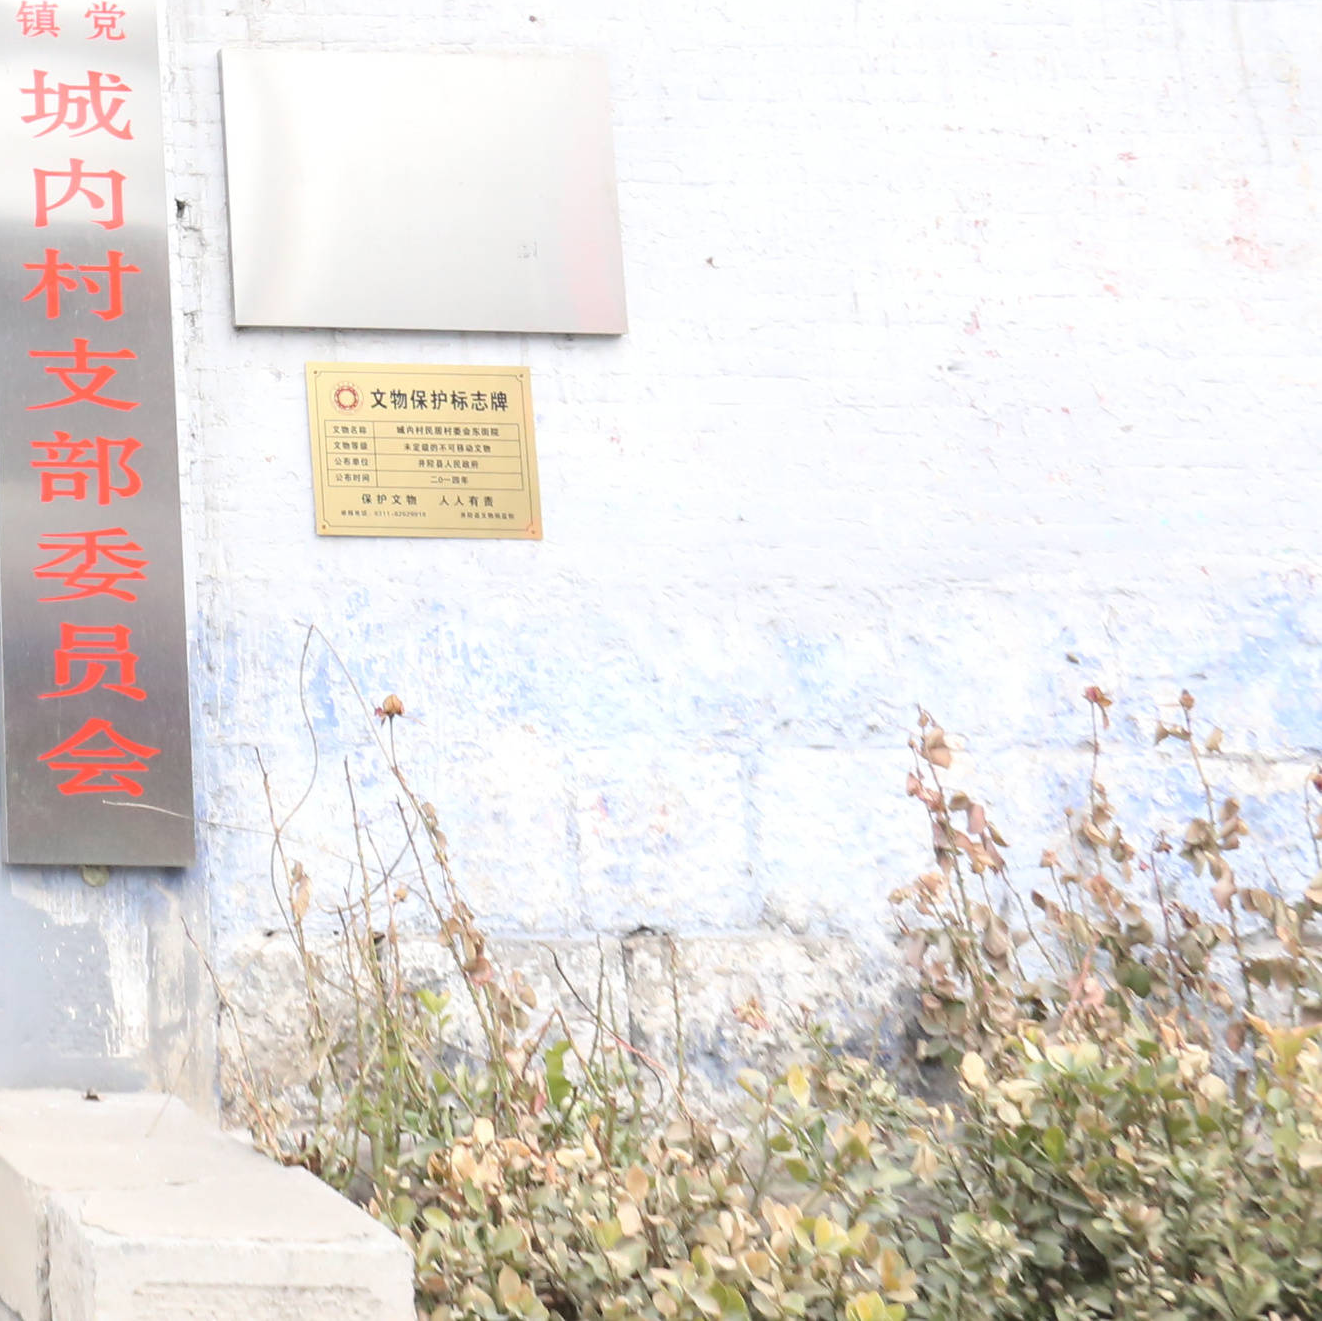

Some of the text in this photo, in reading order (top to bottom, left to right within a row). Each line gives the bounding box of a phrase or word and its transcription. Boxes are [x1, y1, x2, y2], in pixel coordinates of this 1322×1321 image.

[370, 388, 509, 413] 文物保护标志牌
[20, 68, 163, 799] 城内村支部委员会
[361, 493, 419, 506] 保护文物
[439, 495, 495, 508] 人人有责
